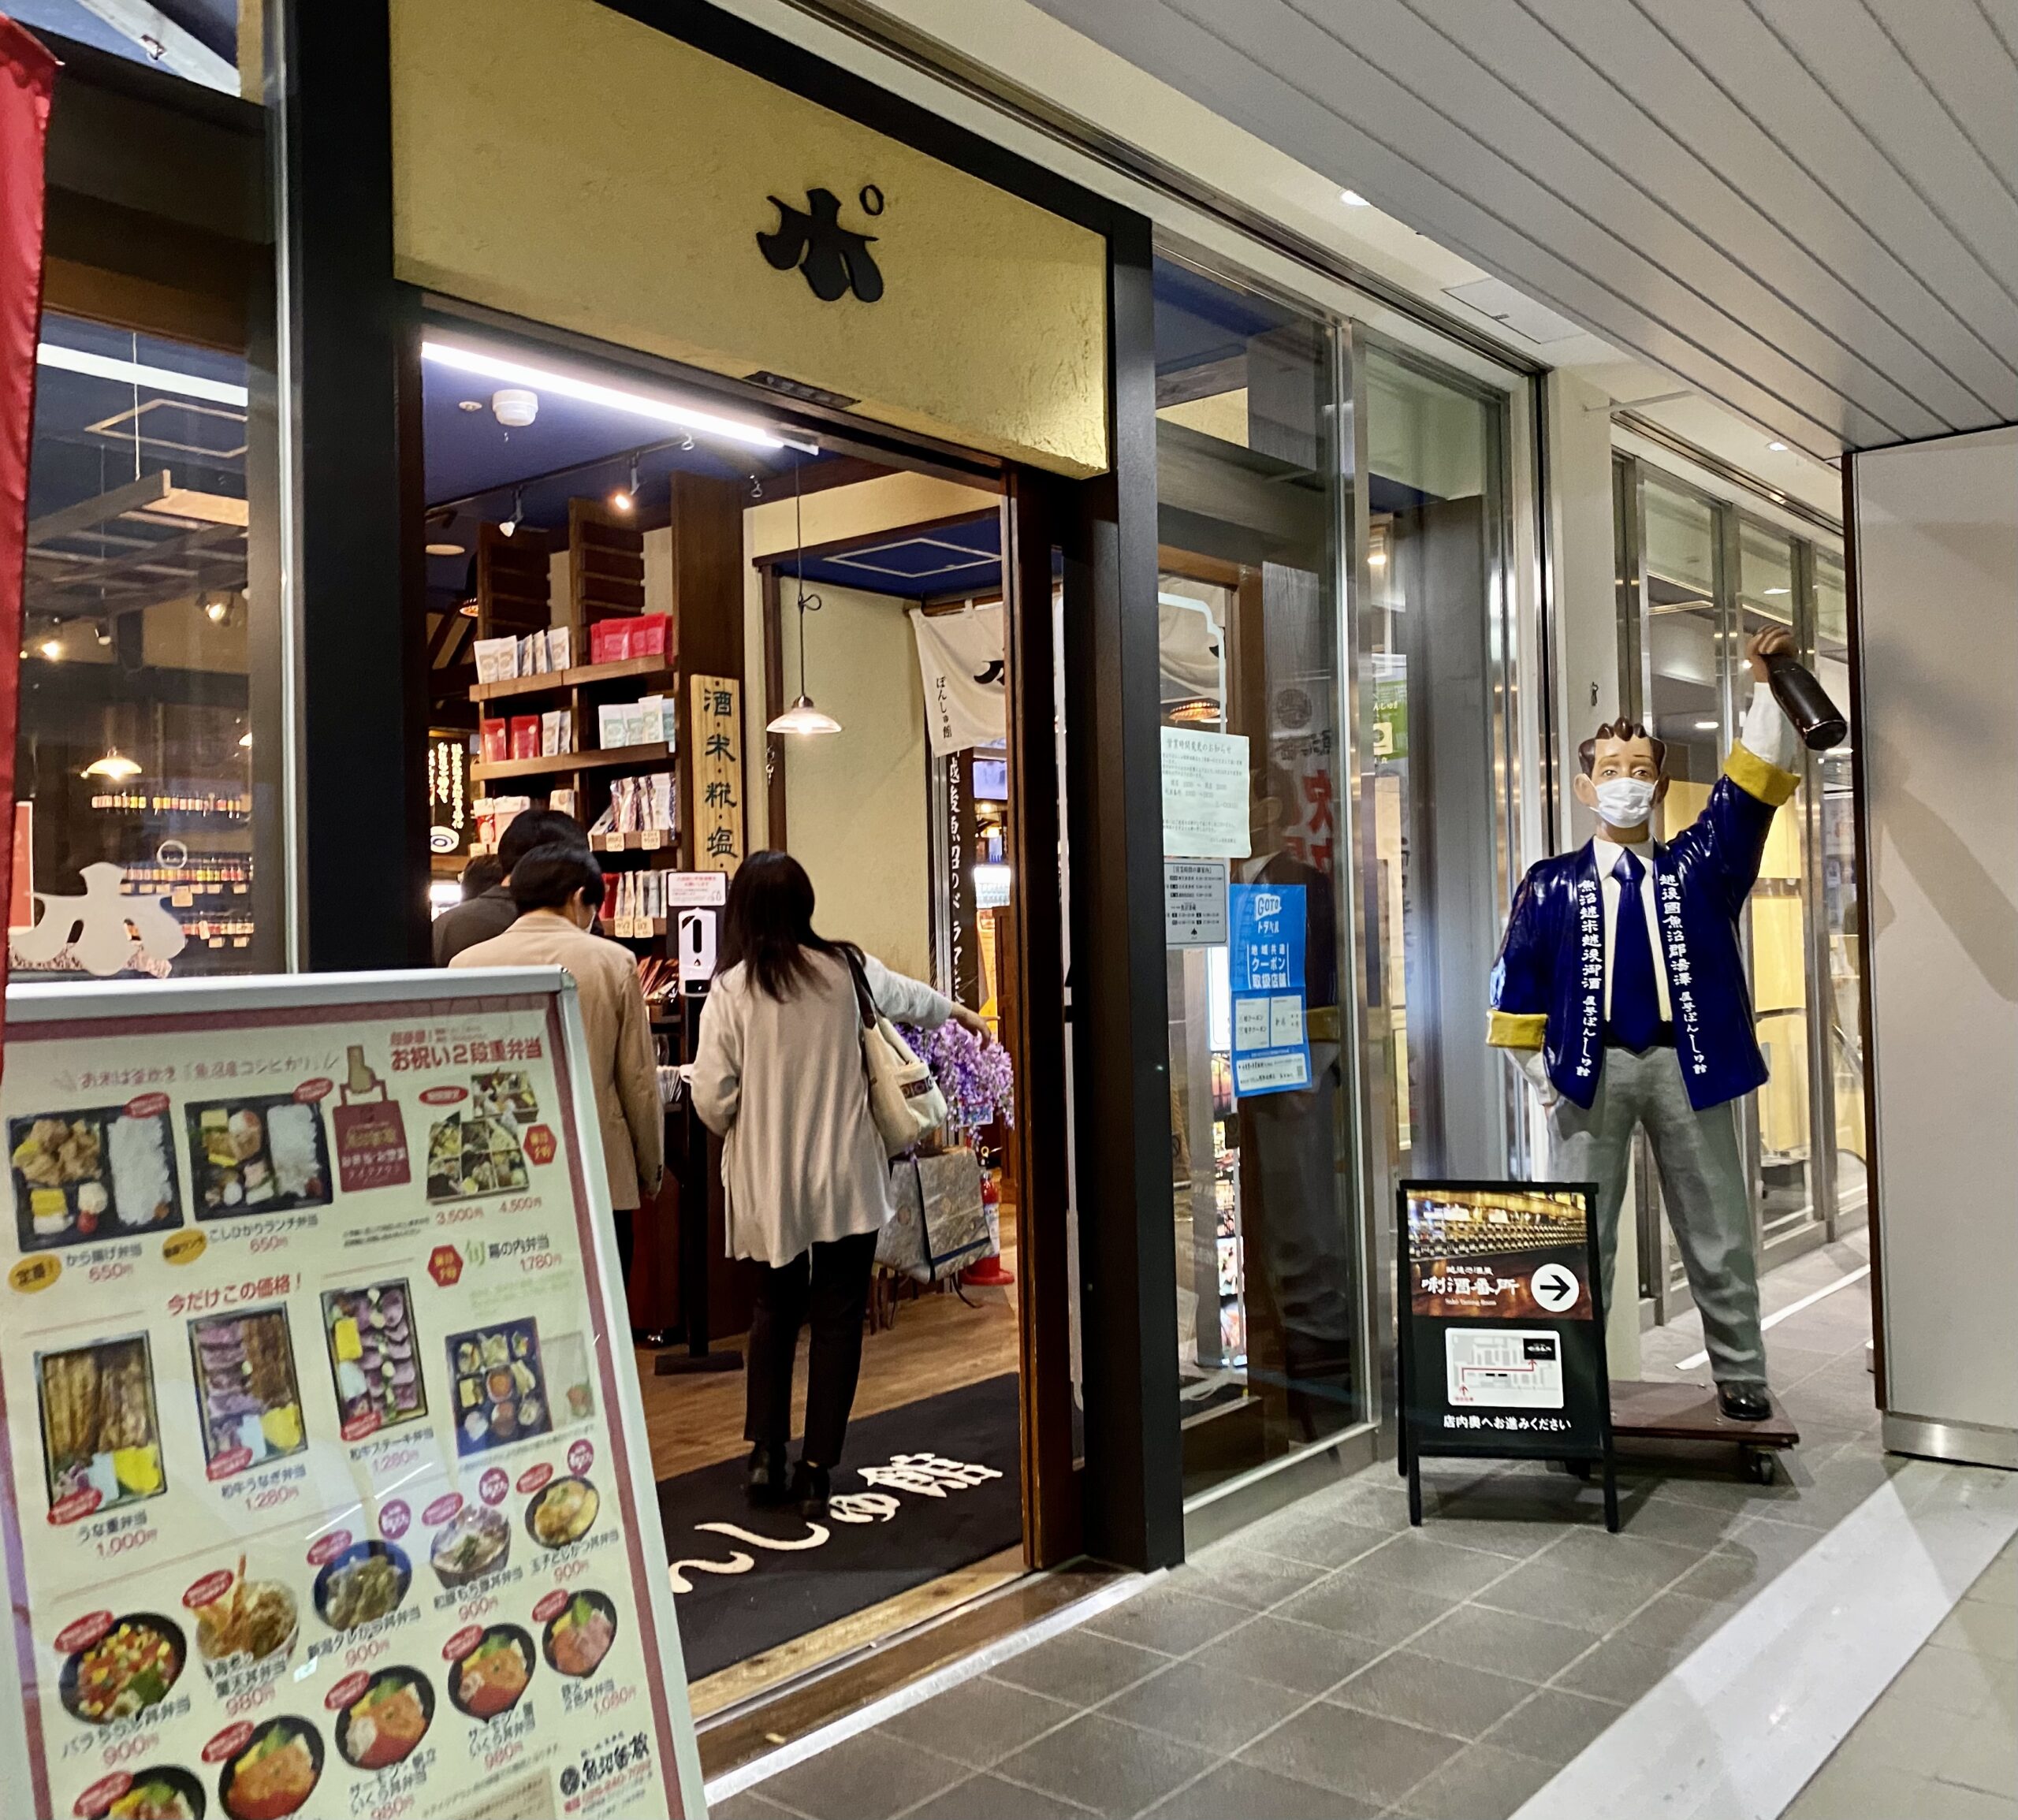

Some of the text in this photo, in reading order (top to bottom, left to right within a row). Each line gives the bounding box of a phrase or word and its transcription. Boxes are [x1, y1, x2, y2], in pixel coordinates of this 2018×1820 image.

[1257, 921, 1279, 934] トラベル
[1252, 955, 1286, 972] クーポン
[1443, 1414, 1572, 1431] 店内奥へお進みください
